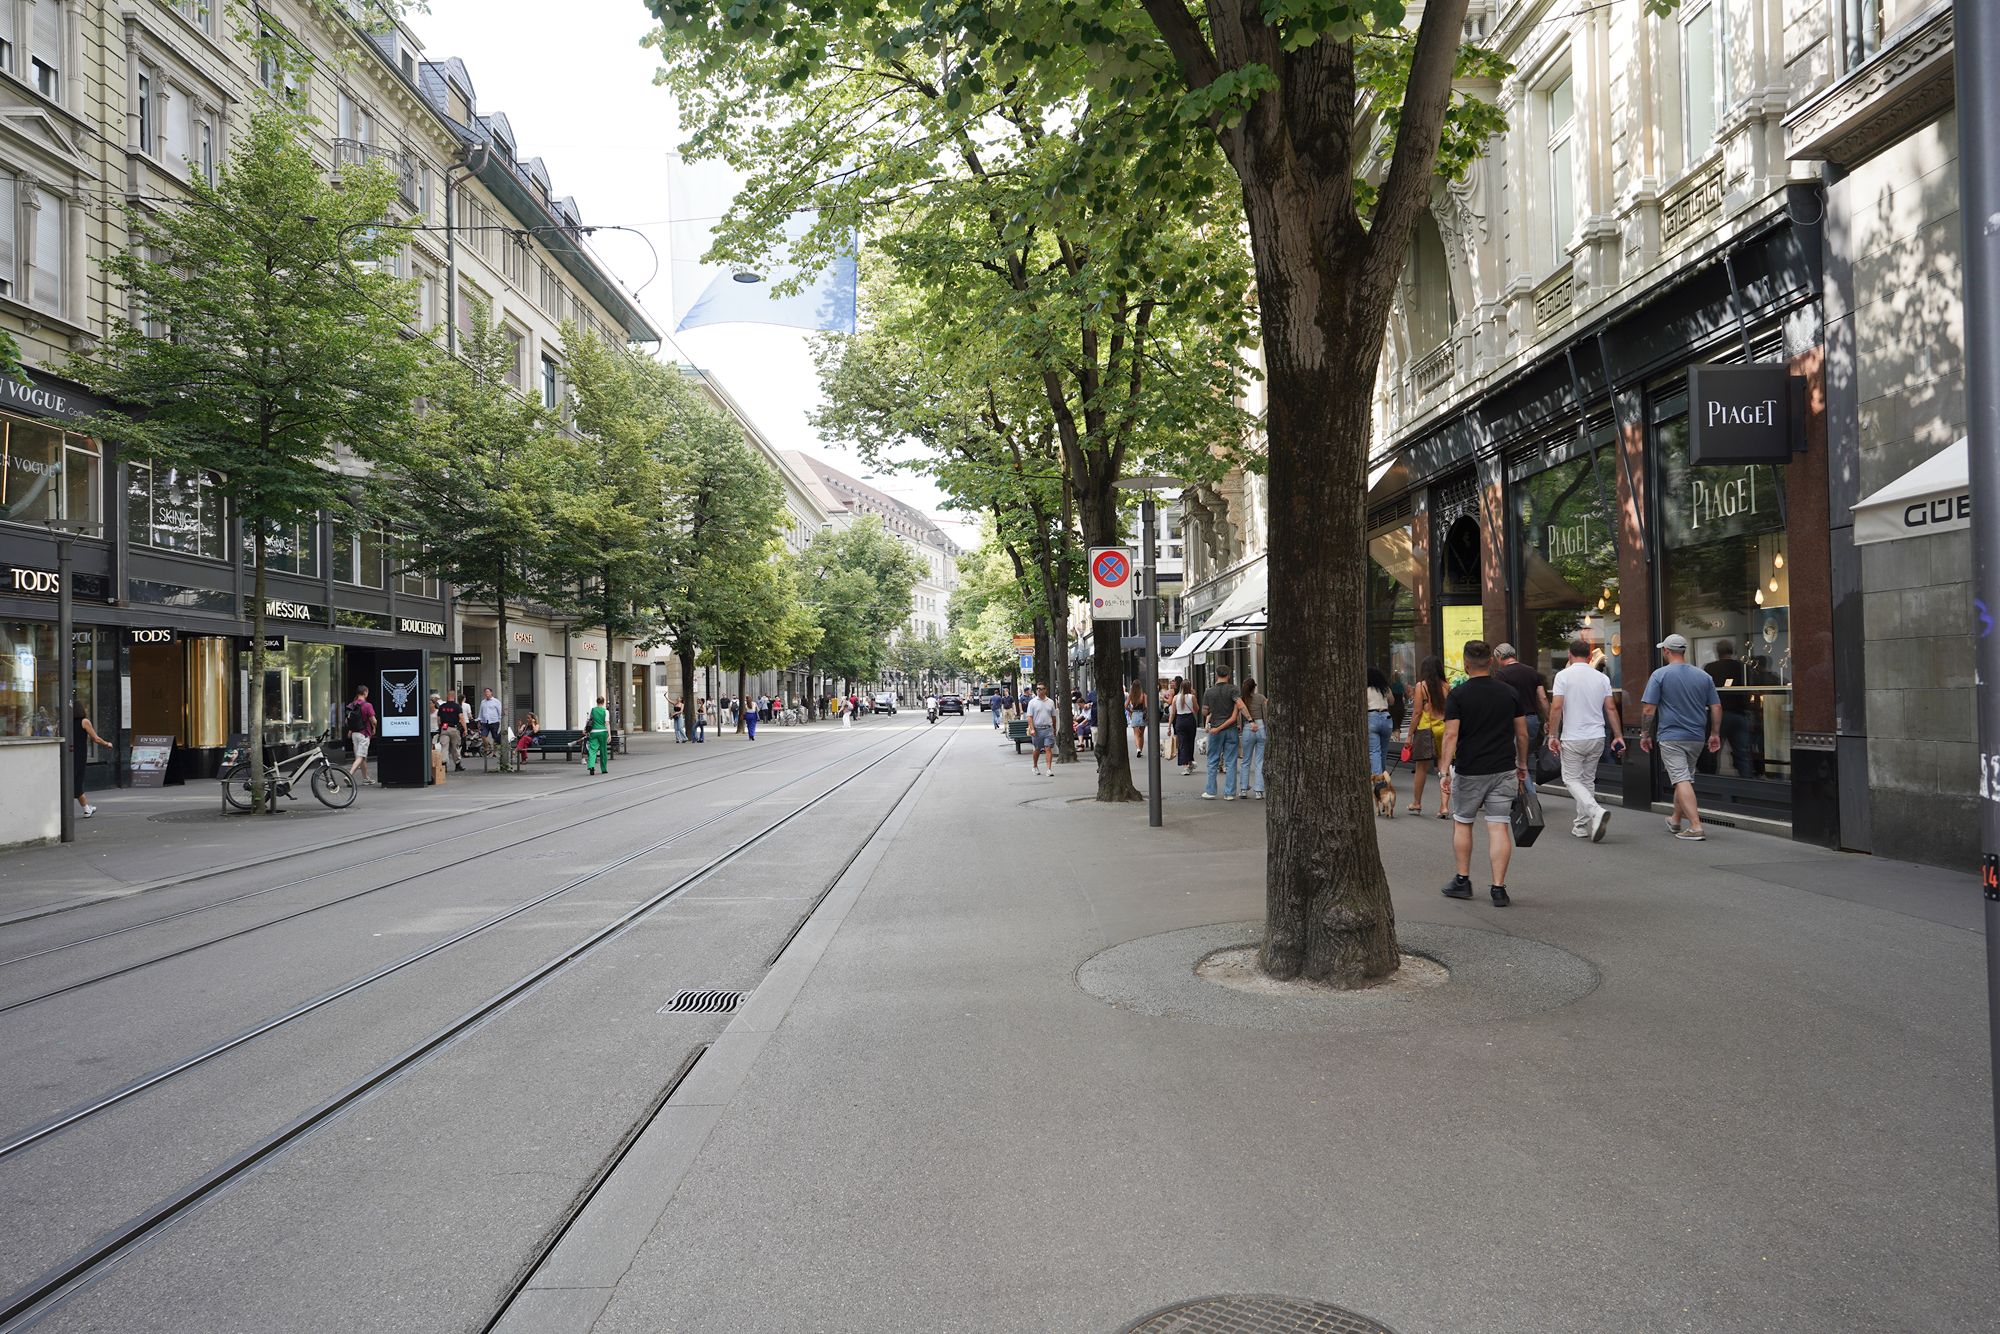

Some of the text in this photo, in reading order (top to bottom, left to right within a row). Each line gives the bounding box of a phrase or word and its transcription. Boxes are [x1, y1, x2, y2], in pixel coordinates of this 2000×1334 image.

[8, 381, 66, 412] VOGUE
[11, 569, 60, 593] TOD'S
[266, 602, 310, 620] MESSIKA
[131, 630, 171, 642] TOD'S
[401, 619, 445, 636] BOUCHERON
